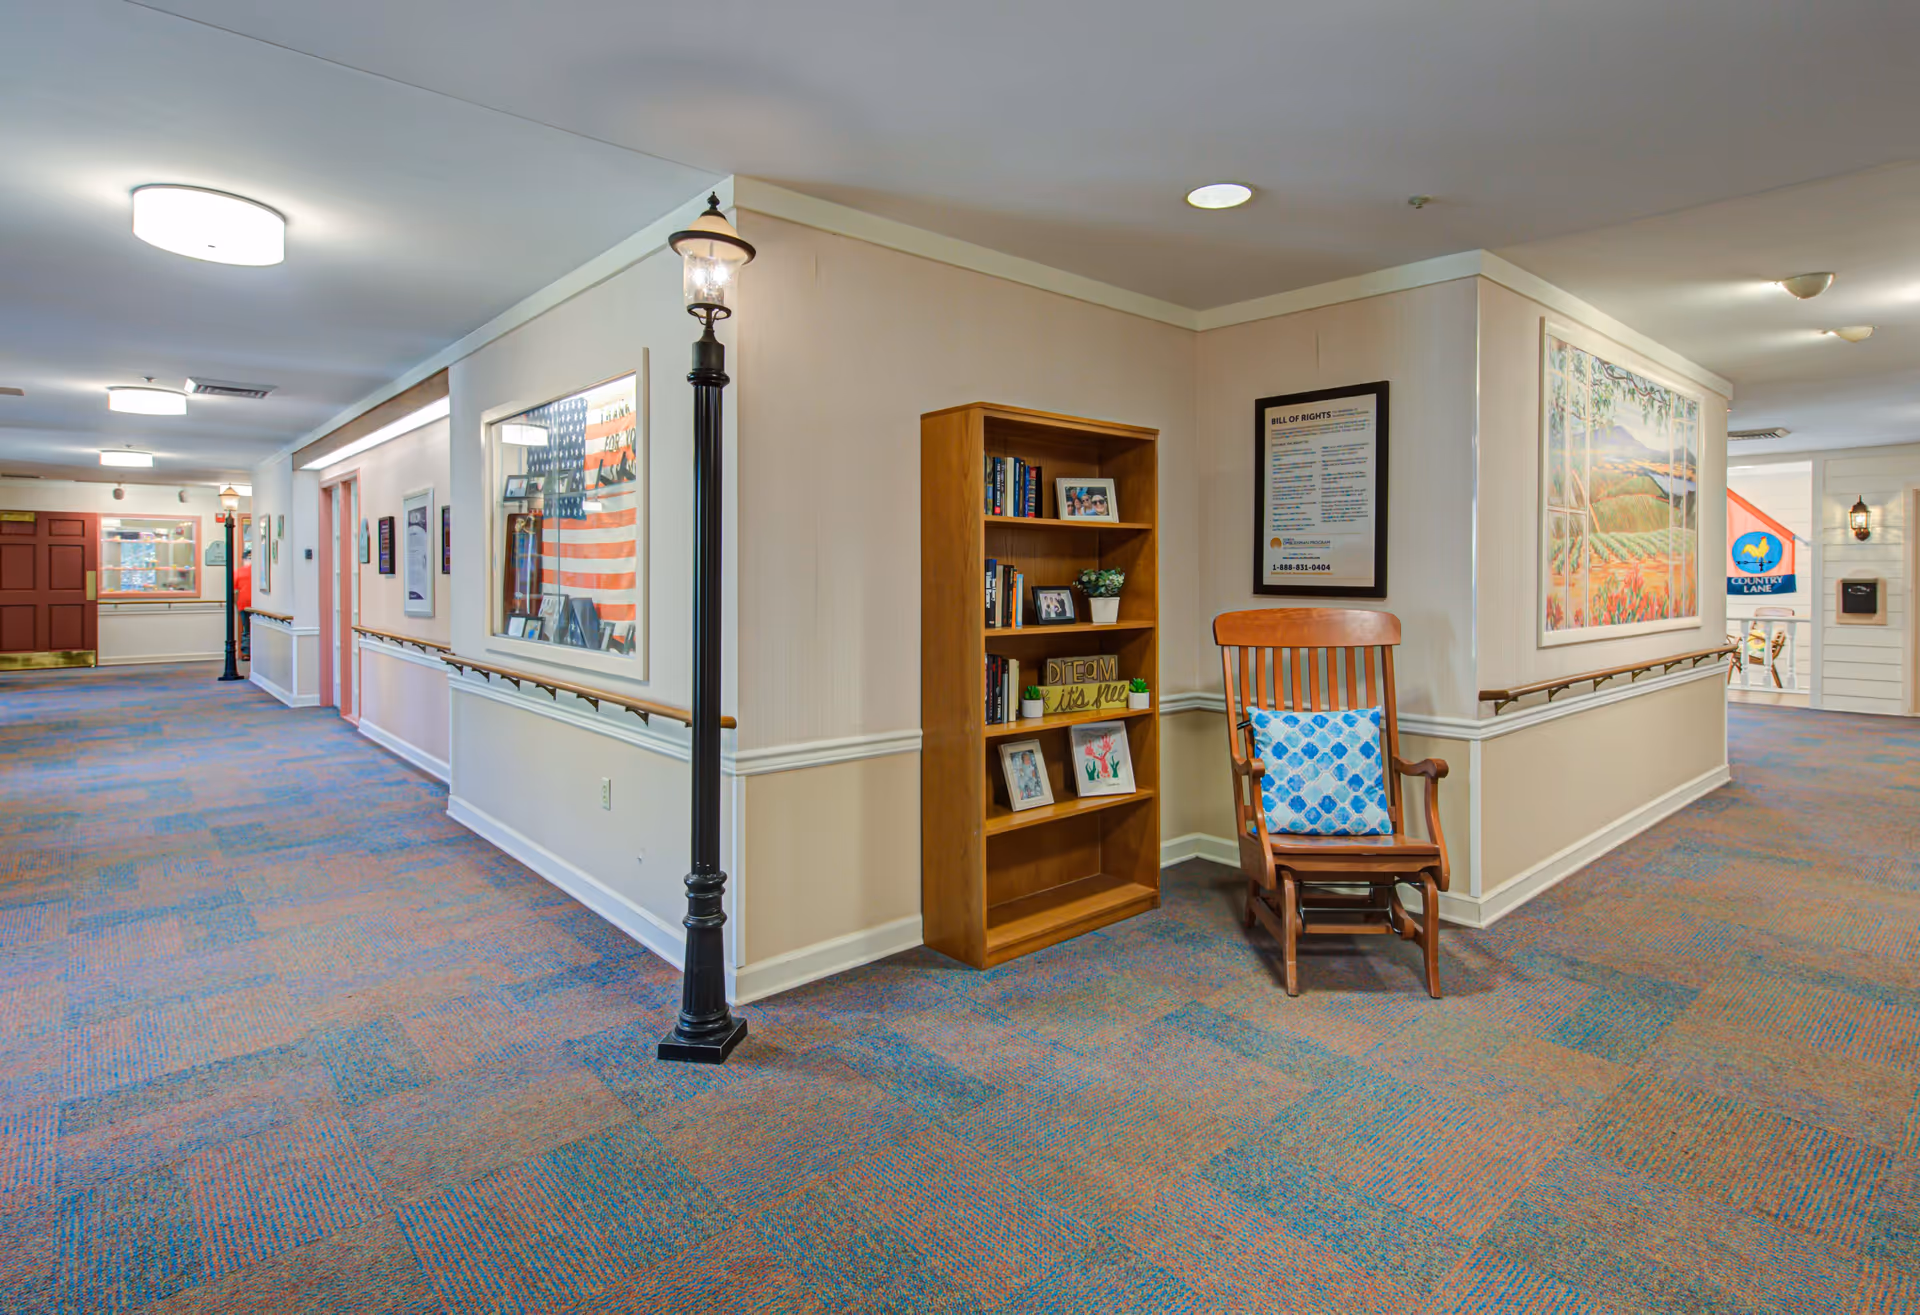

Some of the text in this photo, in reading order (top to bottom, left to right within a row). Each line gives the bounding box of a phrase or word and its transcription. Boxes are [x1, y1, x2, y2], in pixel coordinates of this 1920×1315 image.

[1271, 416, 1287, 425] BILL
[1288, 414, 1300, 423] OF
[1301, 411, 1332, 422] RIGHTS
[1731, 575, 1783, 585] COUNTRY
[1743, 584, 1772, 593] LANE
[1053, 683, 1128, 713] it's free
